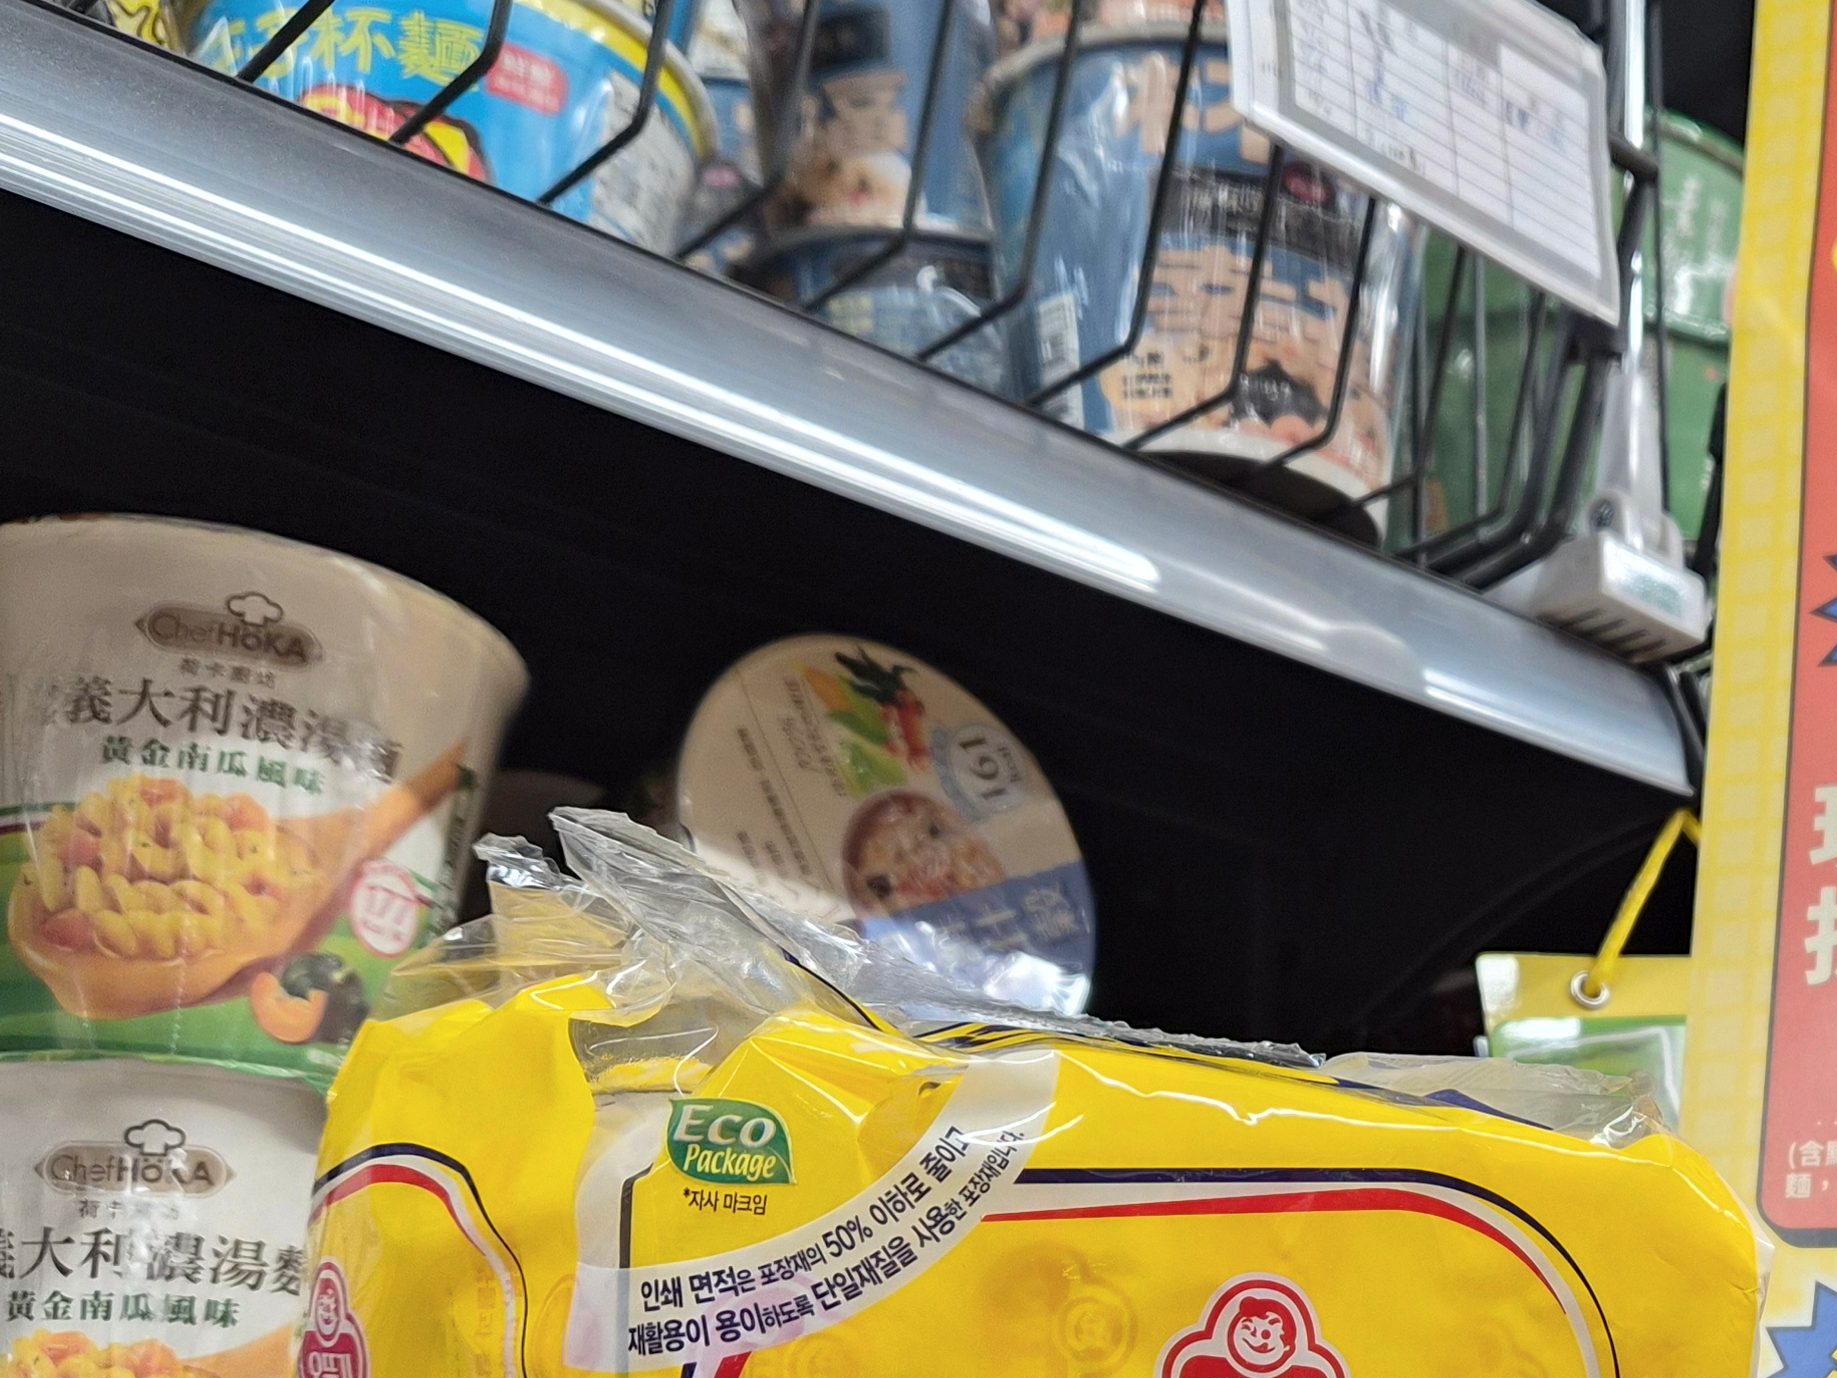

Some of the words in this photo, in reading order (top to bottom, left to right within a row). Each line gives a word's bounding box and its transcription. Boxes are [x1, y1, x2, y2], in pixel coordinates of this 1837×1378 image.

[684, 1144, 778, 1179] Package
[722, 1192, 768, 1217] 마크임
[640, 1277, 683, 1312] 인쇄
[688, 1268, 756, 1303] 면적은
[758, 1241, 828, 1287] 포장재의
[822, 1217, 874, 1261] 50%
[868, 1173, 931, 1228] 이하로
[921, 1127, 972, 1182] 줄이고
[627, 1312, 711, 1357] 재활용이
[714, 1292, 816, 1344] 용이하도록
[809, 1235, 918, 1313] 단일재질을
[915, 1198, 966, 1250] 사용한
